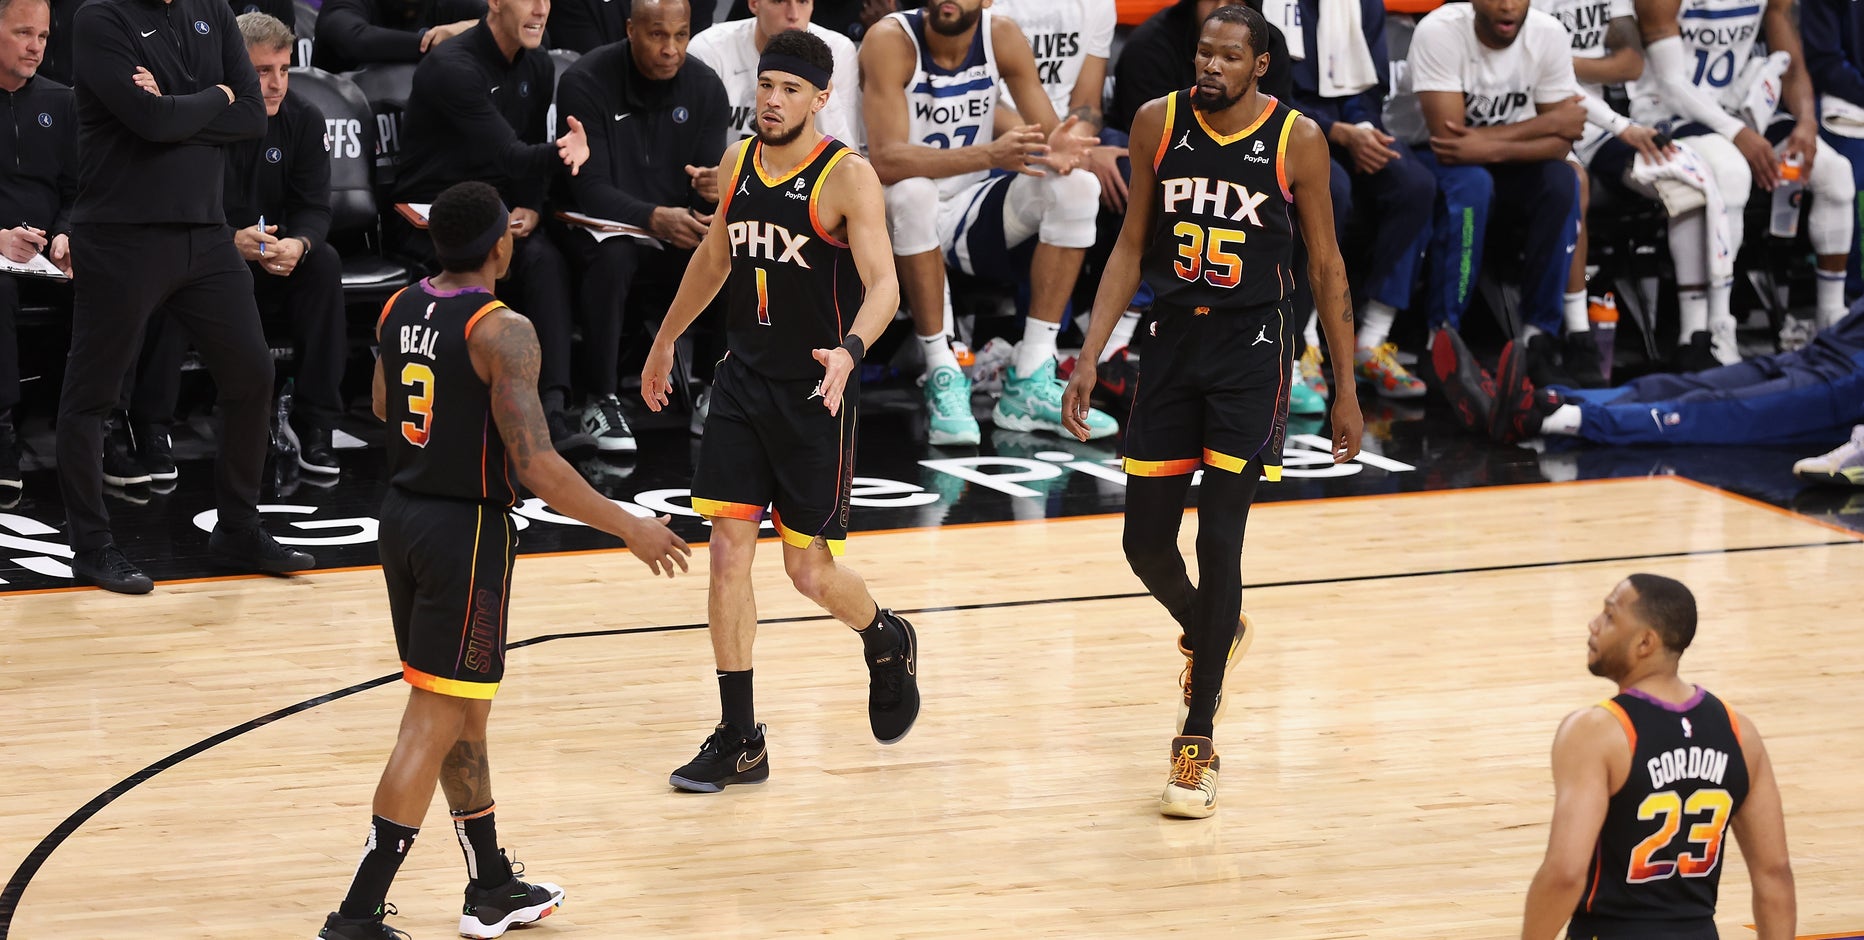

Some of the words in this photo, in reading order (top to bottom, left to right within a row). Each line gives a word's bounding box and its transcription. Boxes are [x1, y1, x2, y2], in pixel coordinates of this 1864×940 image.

[1033, 32, 1079, 58] LVES
[1692, 49, 1735, 87] 10
[916, 97, 990, 125] WOLVES
[1243, 154, 1269, 165] PayPal
[784, 190, 808, 202] PayPal
[1161, 177, 1269, 227] PHX
[727, 220, 812, 269] PHX
[1173, 221, 1246, 289] 35
[755, 267, 772, 326] 1
[400, 324, 439, 360] BEAL
[401, 362, 435, 448] 3
[917, 434, 1416, 497] Piel
[1647, 746, 1728, 790] GORDON
[1626, 788, 1733, 884] 23
